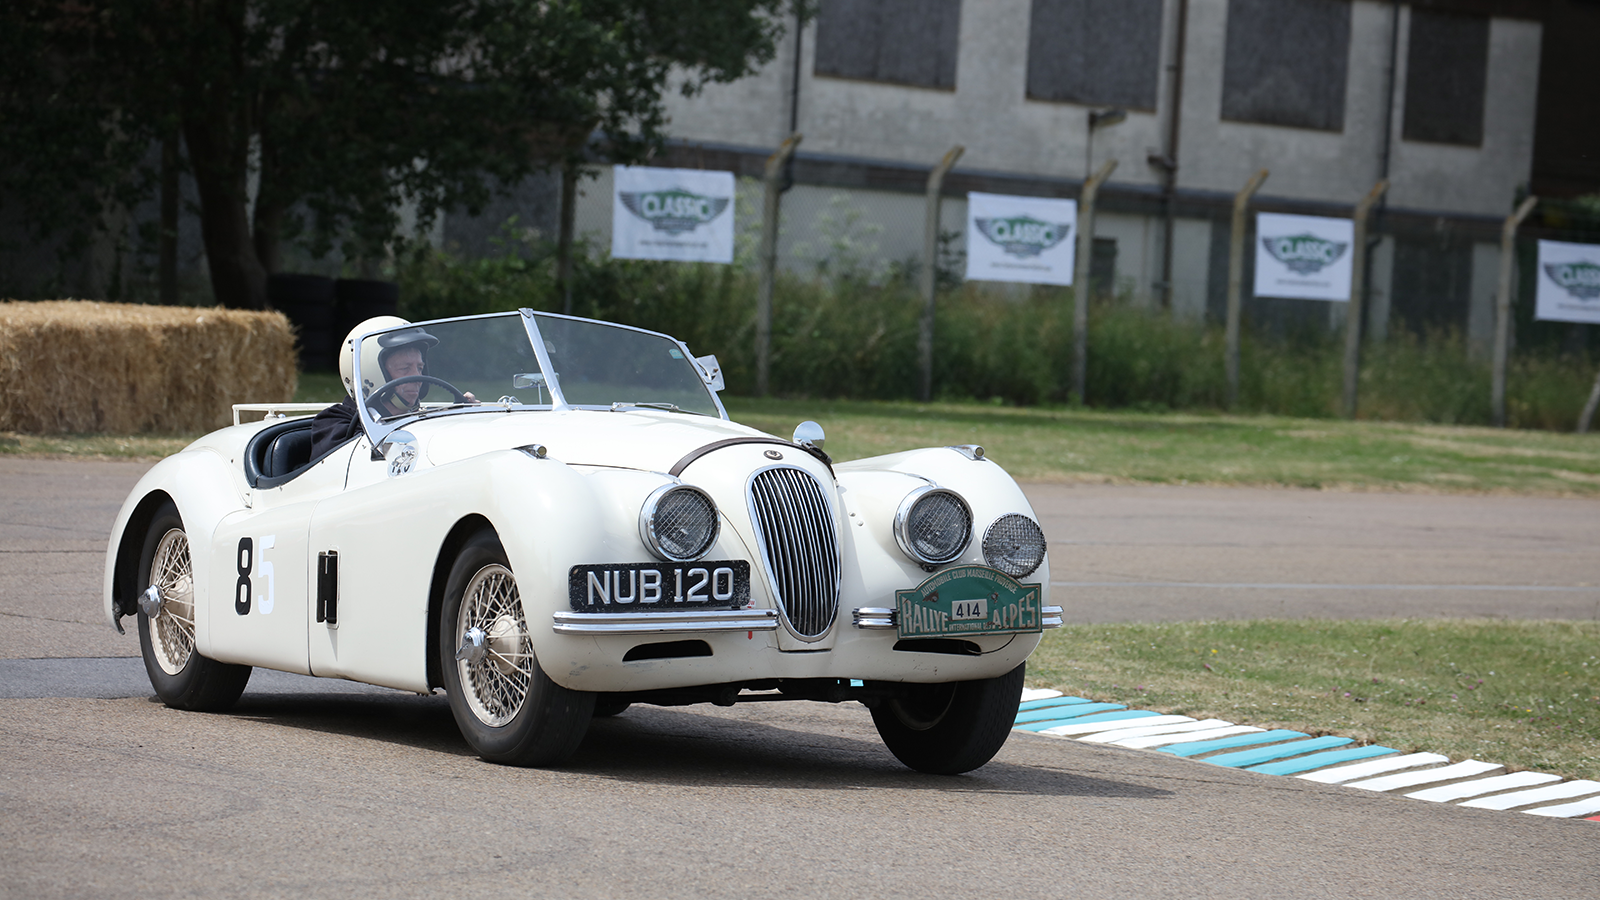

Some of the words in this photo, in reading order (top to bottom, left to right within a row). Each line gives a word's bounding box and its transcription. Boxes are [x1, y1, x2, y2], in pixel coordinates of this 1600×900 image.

[643, 195, 709, 219] CLASSIC
[992, 220, 1056, 248] CLASSIC
[1279, 239, 1335, 263] CLASSIC
[235, 535, 276, 616] 85
[587, 568, 663, 605] NUB
[673, 567, 734, 603] 120
[921, 573, 951, 596] AUTOMOBILE
[952, 569, 967, 579] CLUB
[966, 568, 994, 580] MARSEILLE
[994, 574, 1018, 594] PROVENCE
[902, 597, 948, 632] RALLYE
[993, 591, 1036, 629] ALPES
[956, 602, 981, 618] 414
[948, 622, 983, 631] INTERNATIONAL
